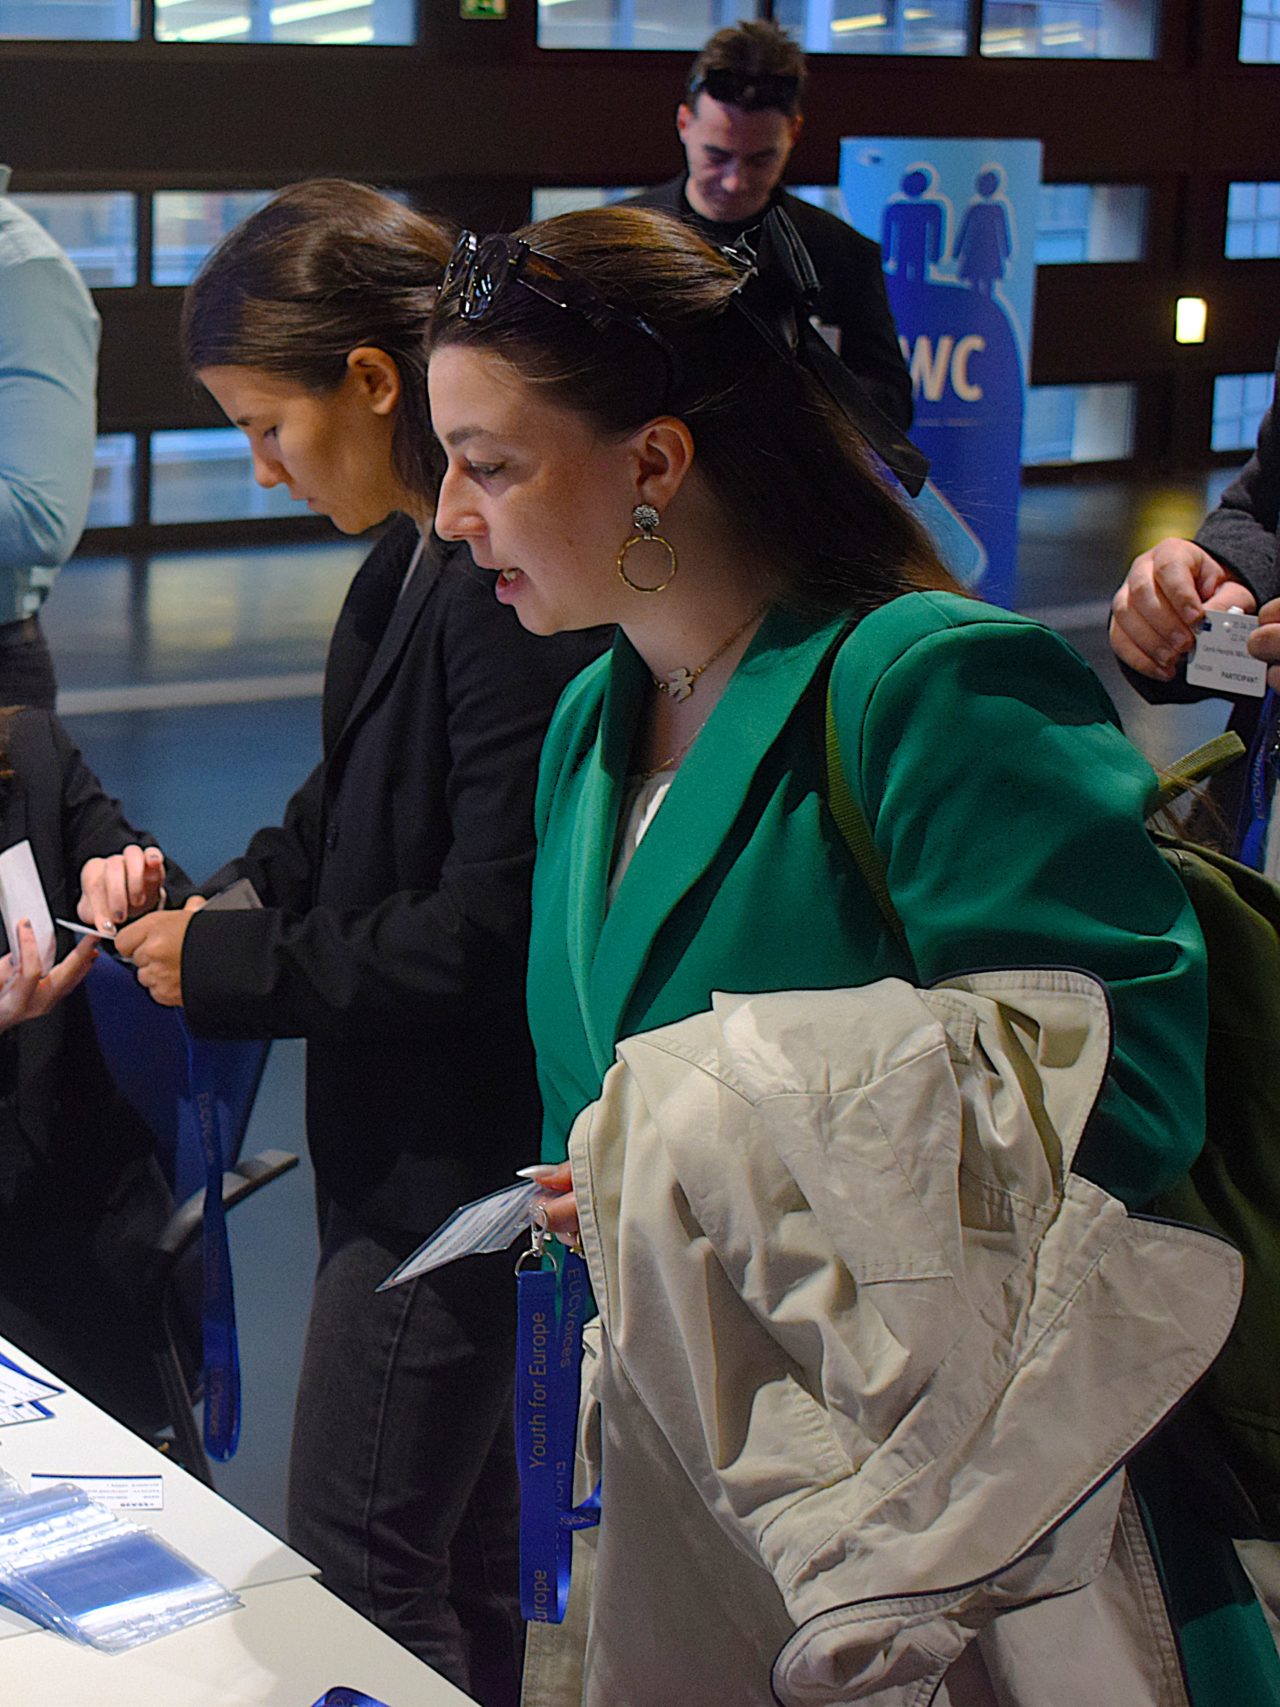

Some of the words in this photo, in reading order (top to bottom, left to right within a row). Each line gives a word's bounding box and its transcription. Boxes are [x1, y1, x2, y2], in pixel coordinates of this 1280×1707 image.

[898, 334, 986, 402] WC
[528, 1312, 549, 1375] Europe
[528, 1383, 547, 1407] for
[528, 1410, 547, 1469] Youth
